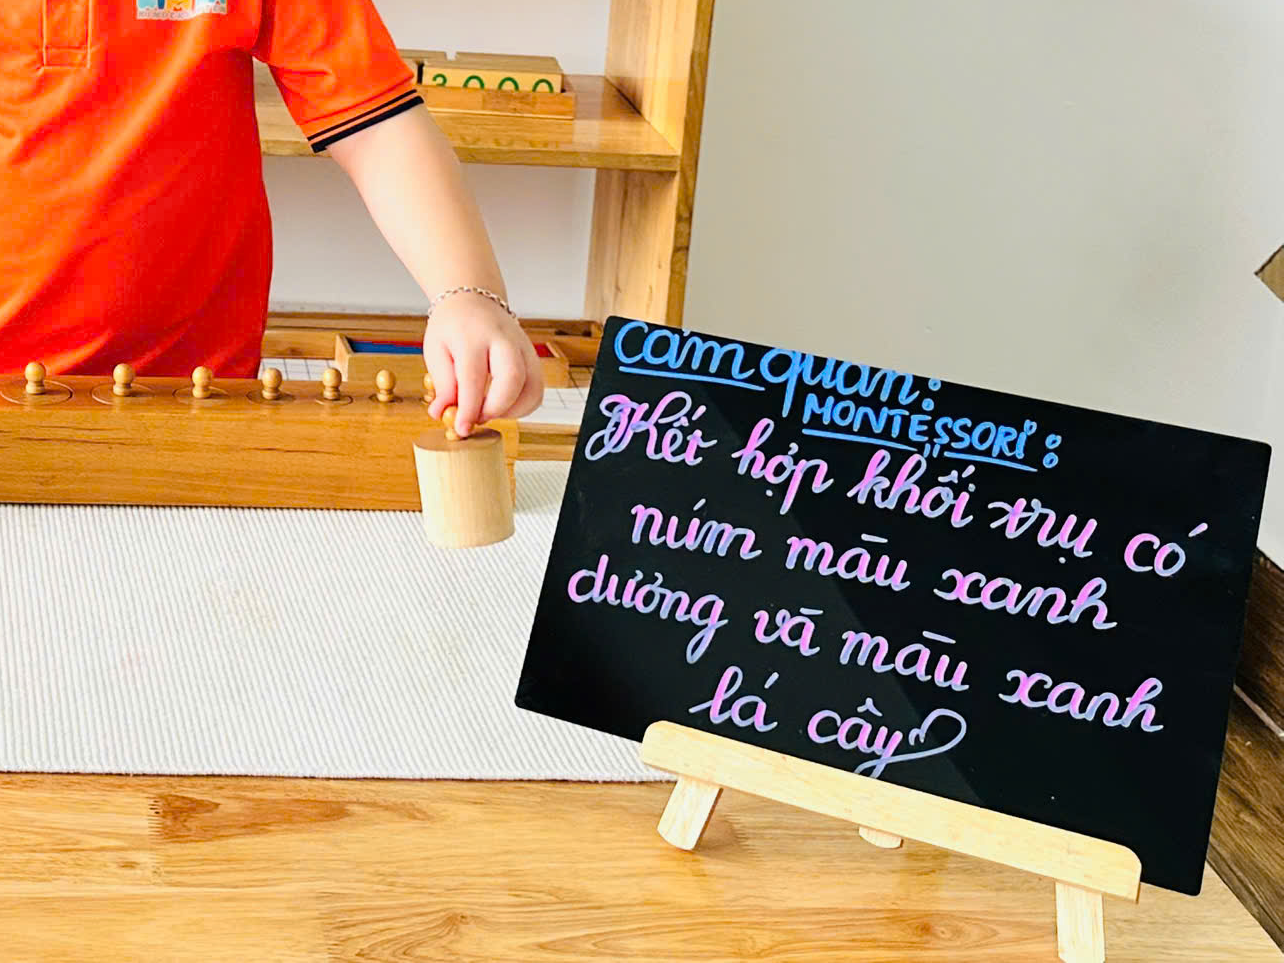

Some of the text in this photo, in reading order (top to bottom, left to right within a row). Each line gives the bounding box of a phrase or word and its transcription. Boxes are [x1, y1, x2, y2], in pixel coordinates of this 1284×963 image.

[631, 499, 762, 559] núm
[933, 568, 1118, 630] xanh
[846, 449, 976, 528] khối
[1124, 522, 1209, 577] có
[688, 665, 906, 779] lá cây
[999, 669, 1164, 732] xanh
